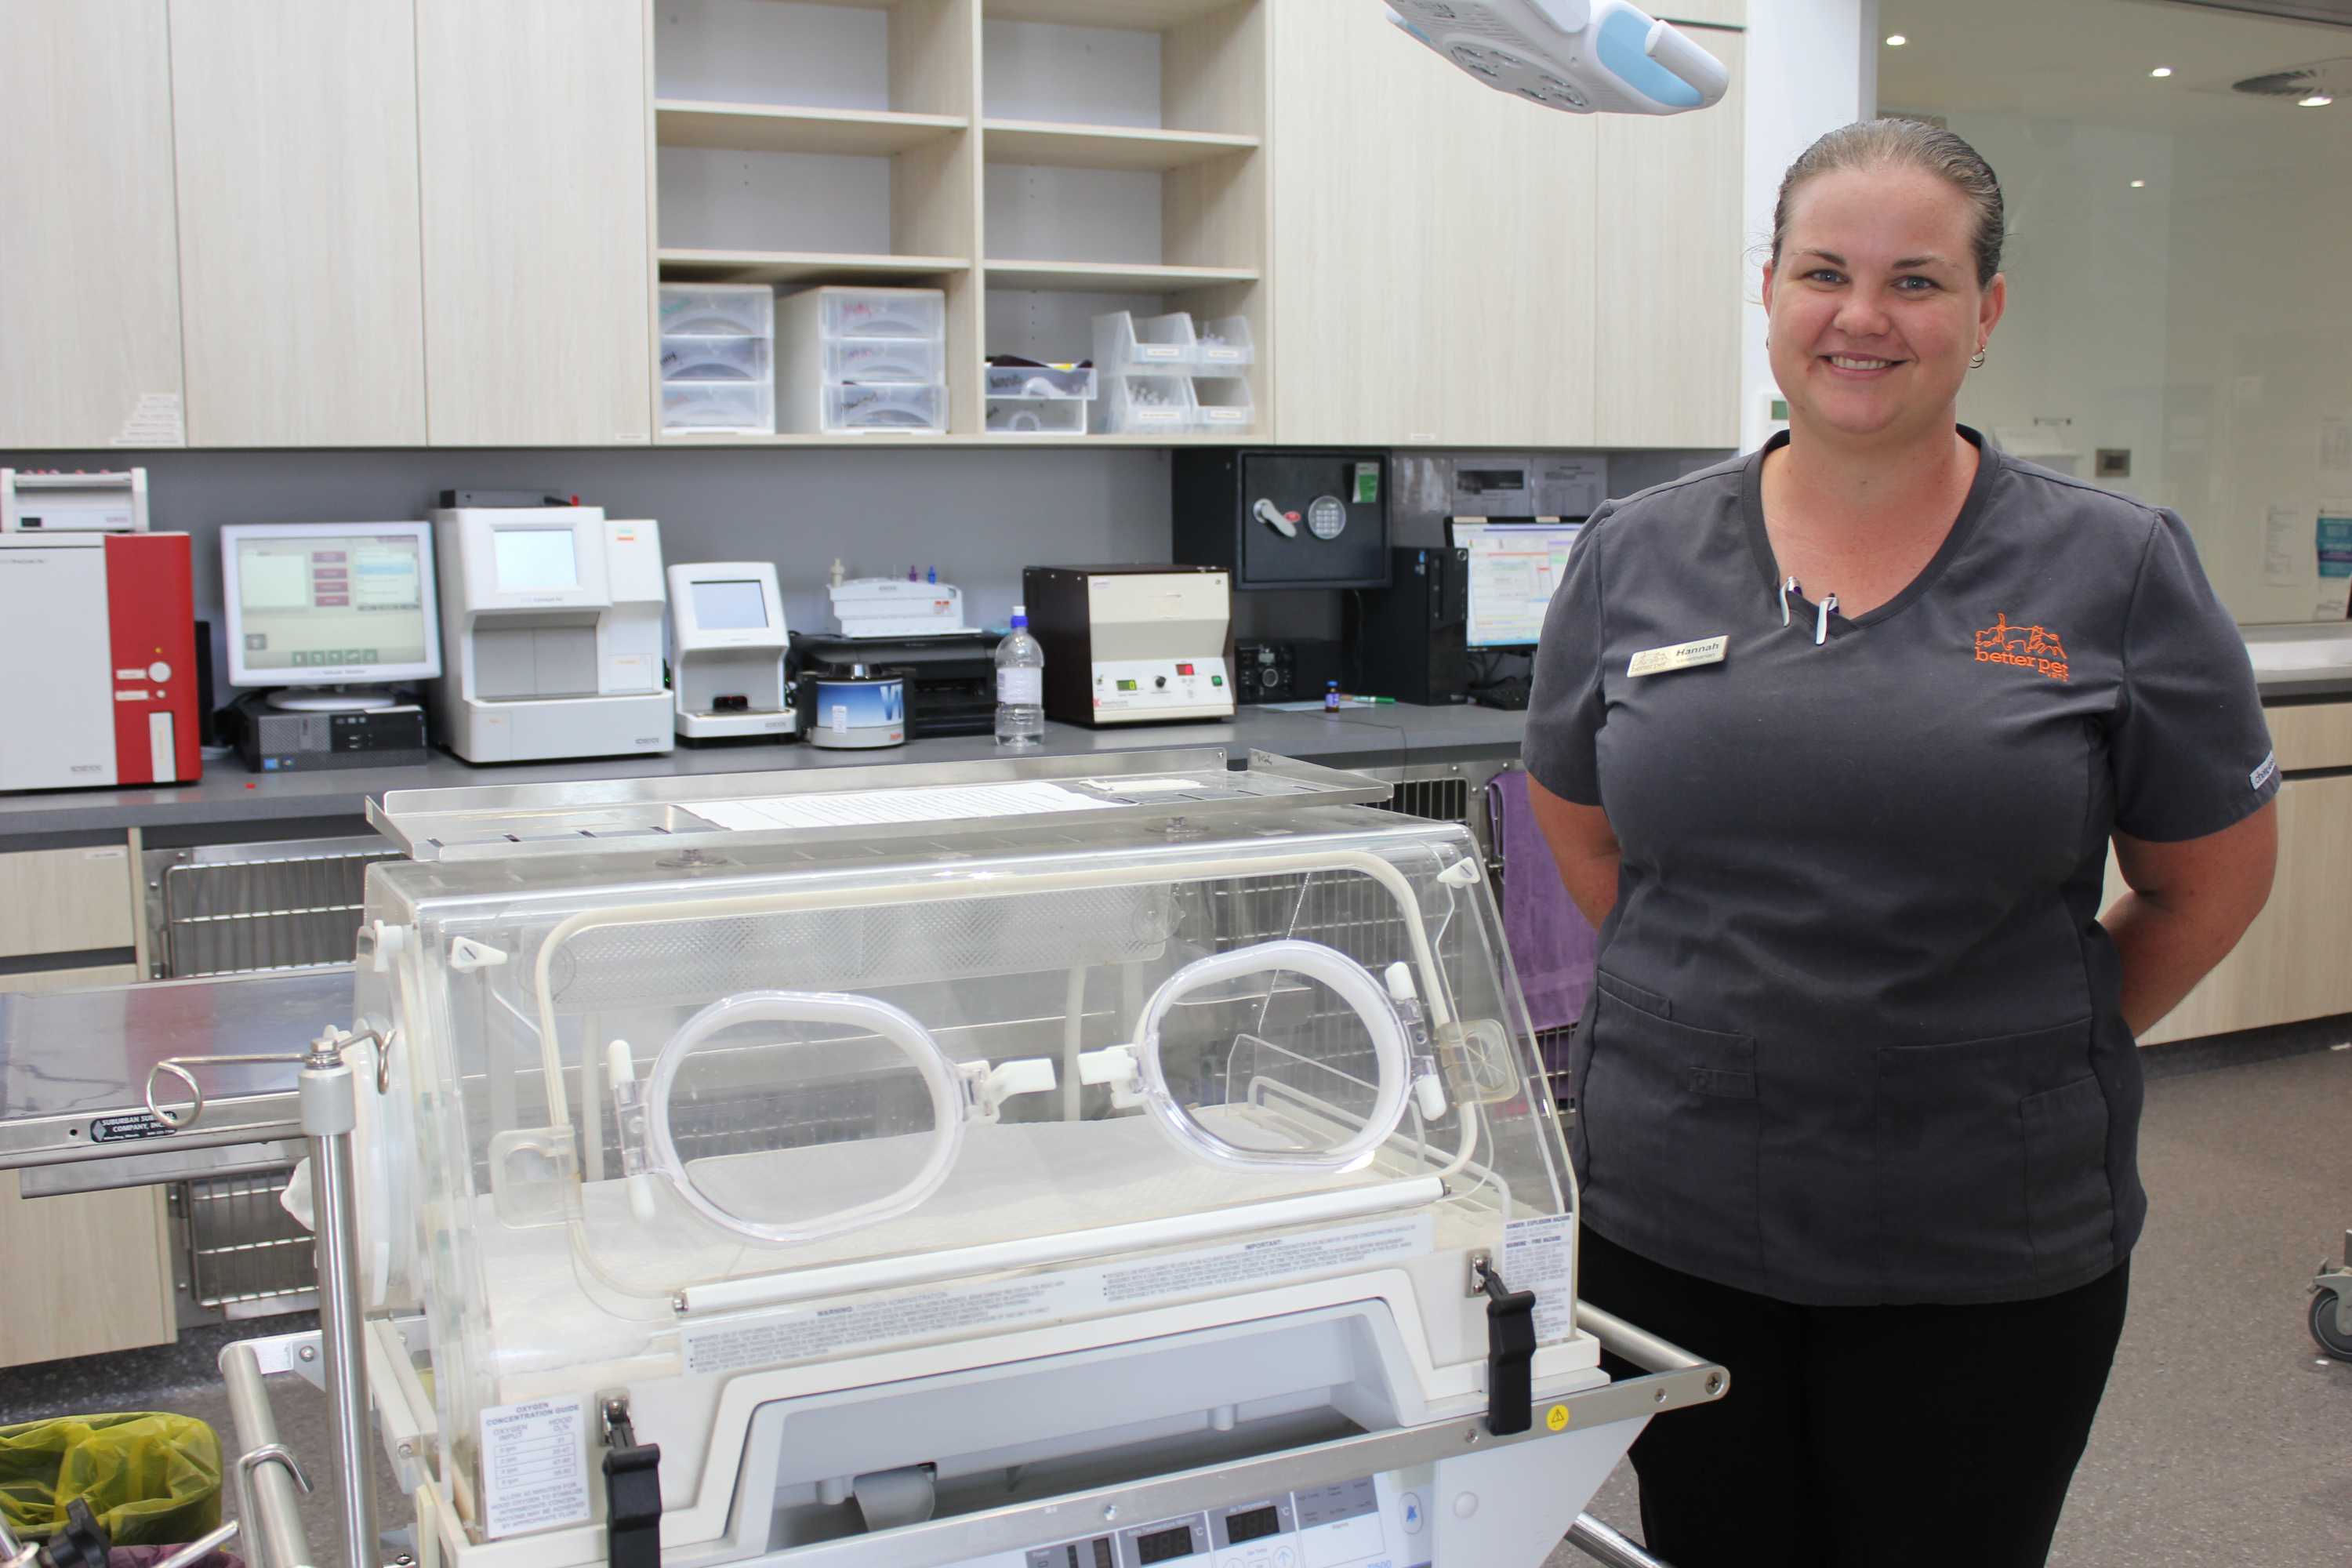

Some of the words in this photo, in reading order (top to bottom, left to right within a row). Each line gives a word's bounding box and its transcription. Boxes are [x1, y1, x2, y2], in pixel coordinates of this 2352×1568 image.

[1675, 642, 1719, 656] Hannah
[1974, 646, 2036, 667] better
[2037, 658, 2069, 673] pet
[102, 1116, 140, 1126] SUBURBAN
[516, 1402, 550, 1414] OXYGEN
[486, 1409, 553, 1426] CONCENTRATION
